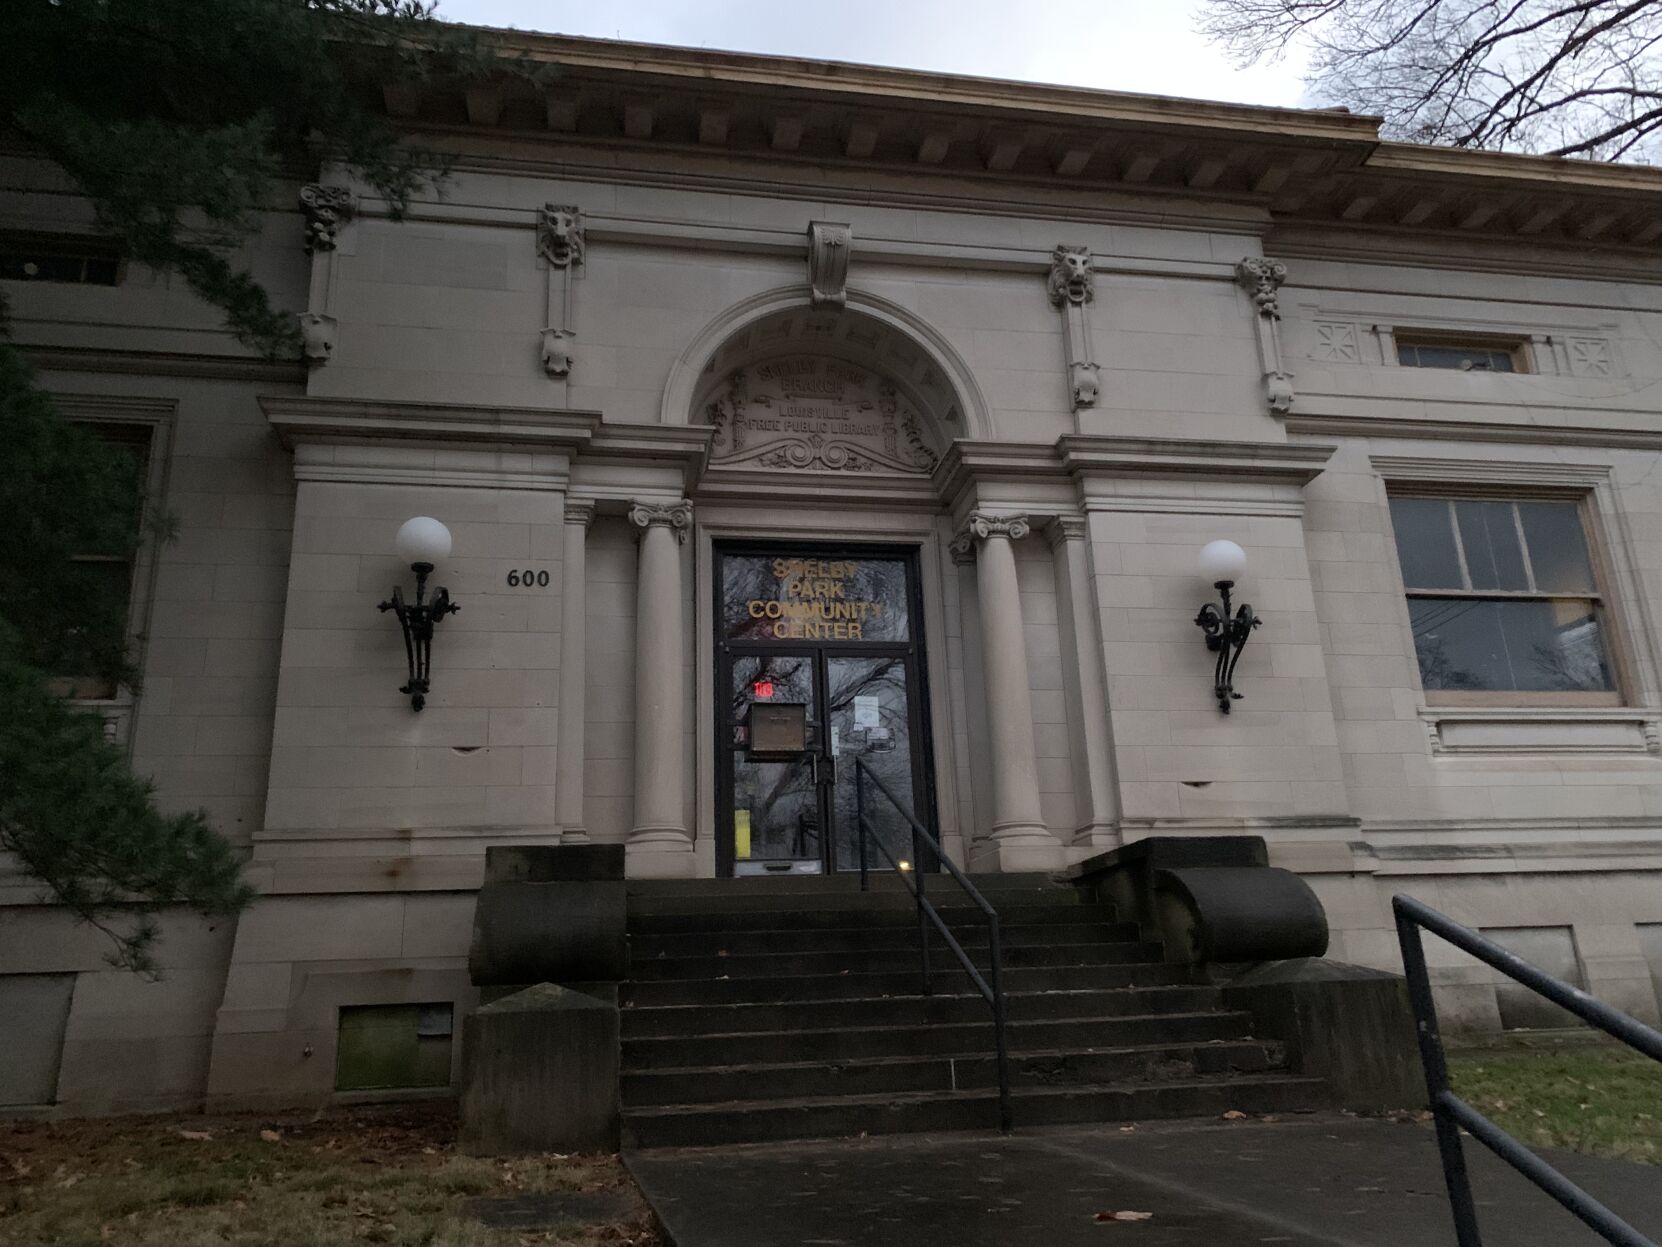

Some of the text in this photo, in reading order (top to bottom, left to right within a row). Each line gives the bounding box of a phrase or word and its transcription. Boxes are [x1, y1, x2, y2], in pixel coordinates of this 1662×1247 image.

[780, 377, 846, 394] BRANCH
[778, 406, 850, 421] LOUISVILLE
[748, 418, 881, 436] FREE PUBLIC LIBRARY
[507, 569, 550, 587] 600
[788, 580, 846, 599] PARK
[748, 601, 882, 620] COMMUNITY
[773, 622, 864, 640] CENTER
